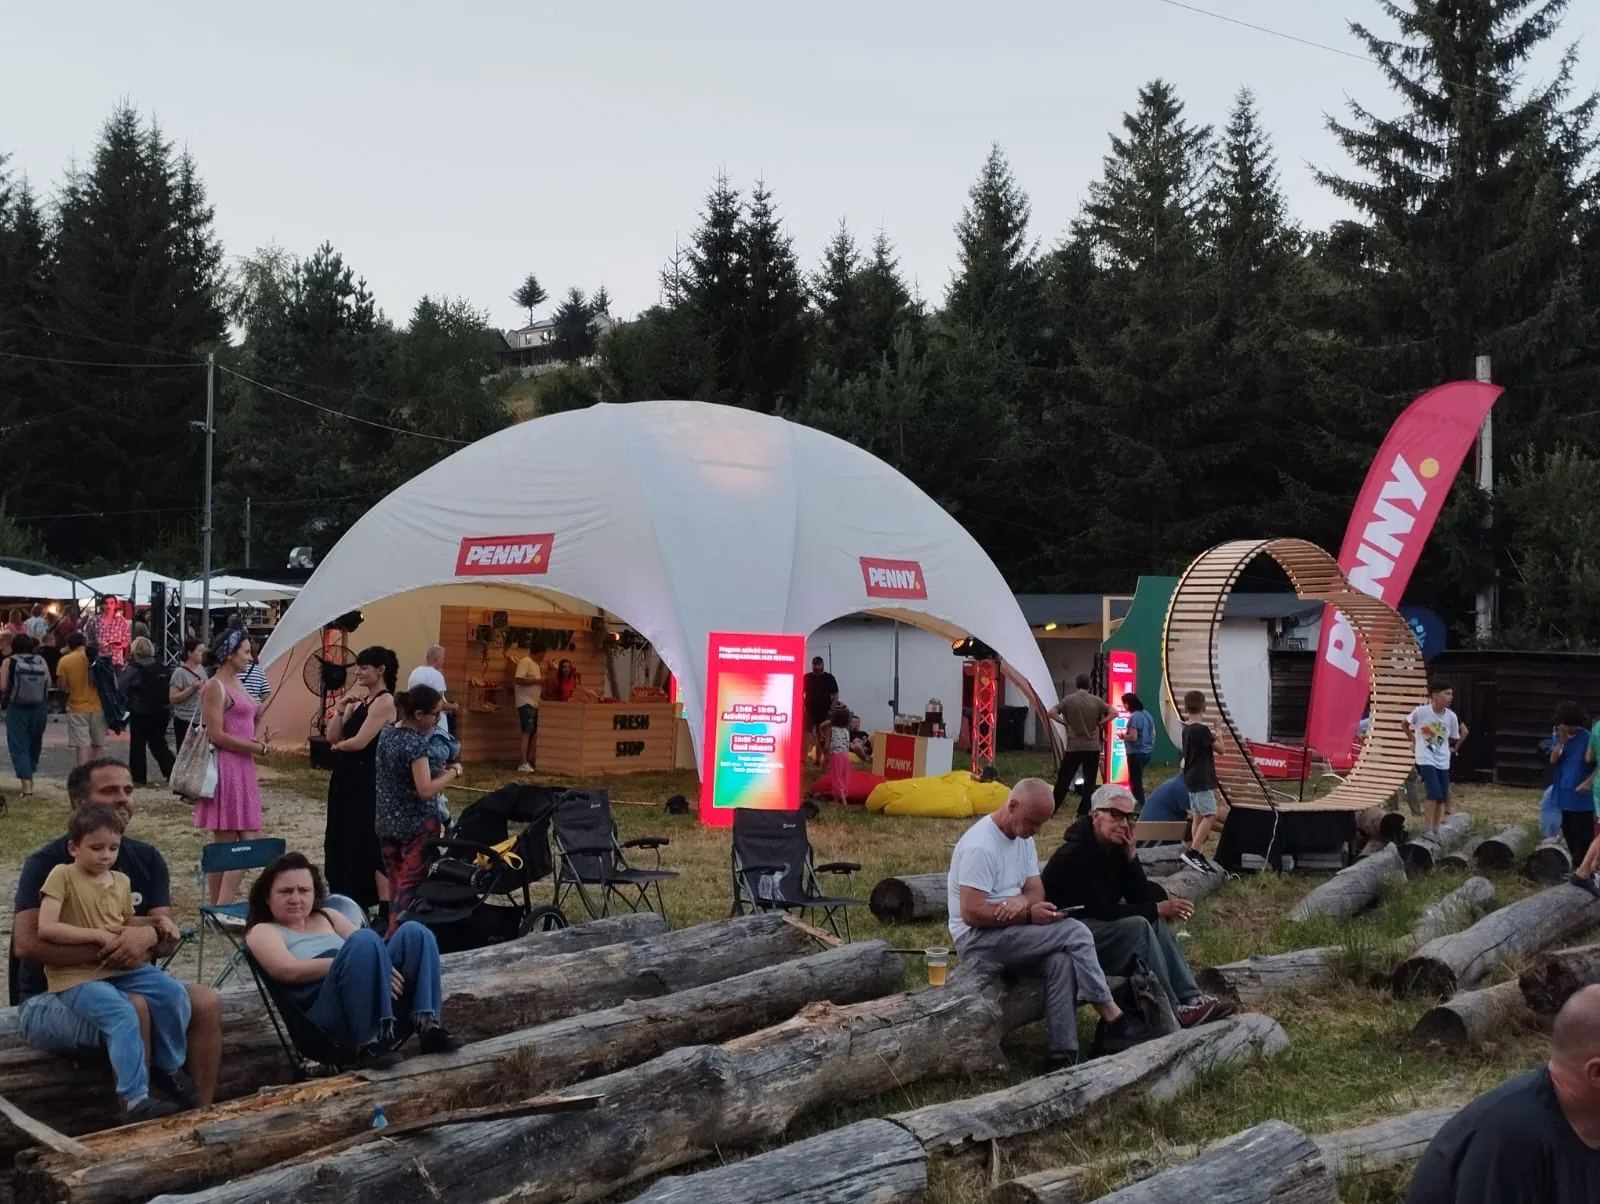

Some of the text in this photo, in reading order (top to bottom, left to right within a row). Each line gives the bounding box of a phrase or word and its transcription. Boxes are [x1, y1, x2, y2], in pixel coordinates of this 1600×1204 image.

[465, 543, 542, 565] PENNY.
[1325, 453, 1440, 678] PNNY.
[868, 567, 920, 591] PENNY.
[613, 714, 649, 730] FRESH
[616, 741, 645, 756] STOP
[886, 757, 913, 773] PENNY.
